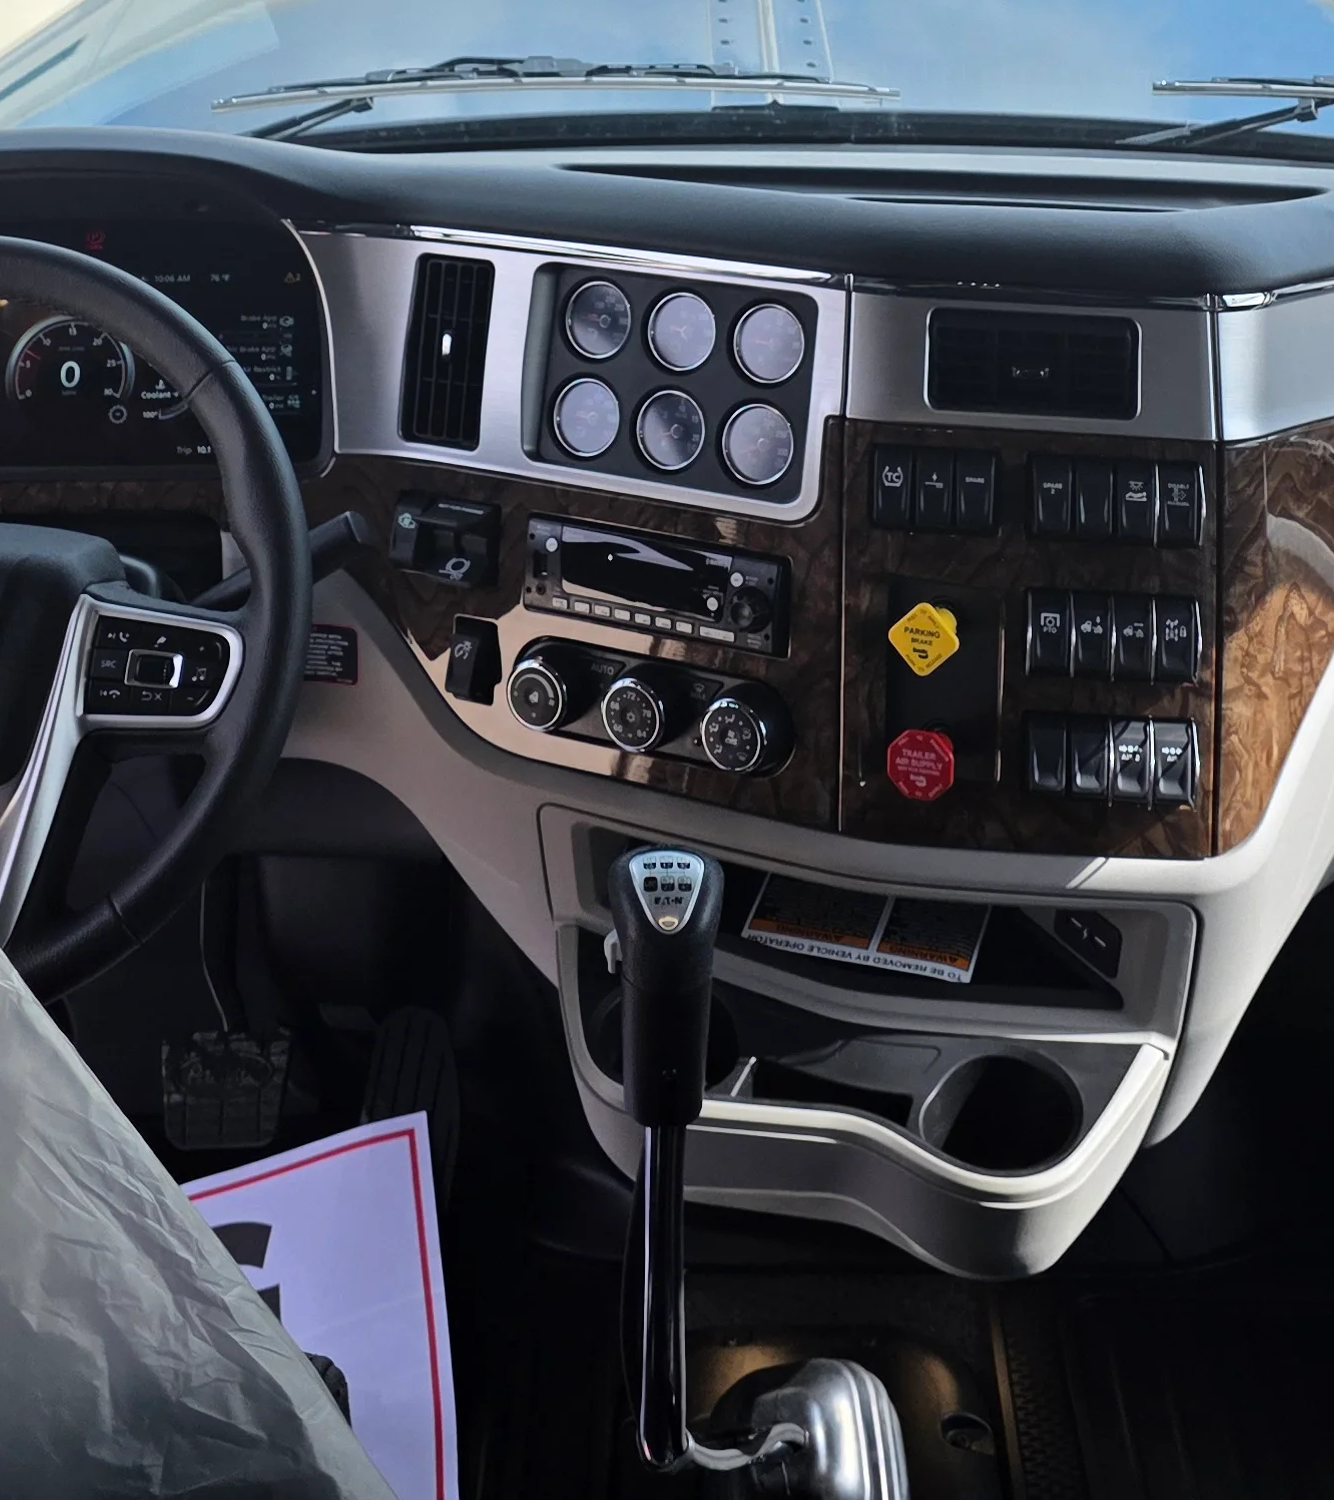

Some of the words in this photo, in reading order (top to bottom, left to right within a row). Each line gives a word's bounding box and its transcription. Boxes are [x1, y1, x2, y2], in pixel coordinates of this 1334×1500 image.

[176, 274, 191, 282] AM
[60, 360, 81, 388] 0
[141, 391, 172, 400] Coolant
[176, 445, 192, 455] Trip
[886, 471, 899, 483] TC
[903, 626, 941, 639] PARKING
[101, 659, 117, 669] SRC
[591, 663, 614, 676] AUTO
[902, 748, 937, 761] TRAILER
[775, 924, 833, 942] WARNING
[746, 933, 805, 951] OPERATOR
[807, 943, 853, 960] VEHICLE
[887, 944, 949, 963] WARNING
[855, 953, 871, 964] BY
[873, 955, 928, 973] REMOVED
[930, 967, 945, 977] BE
[947, 972, 962, 982] TO
